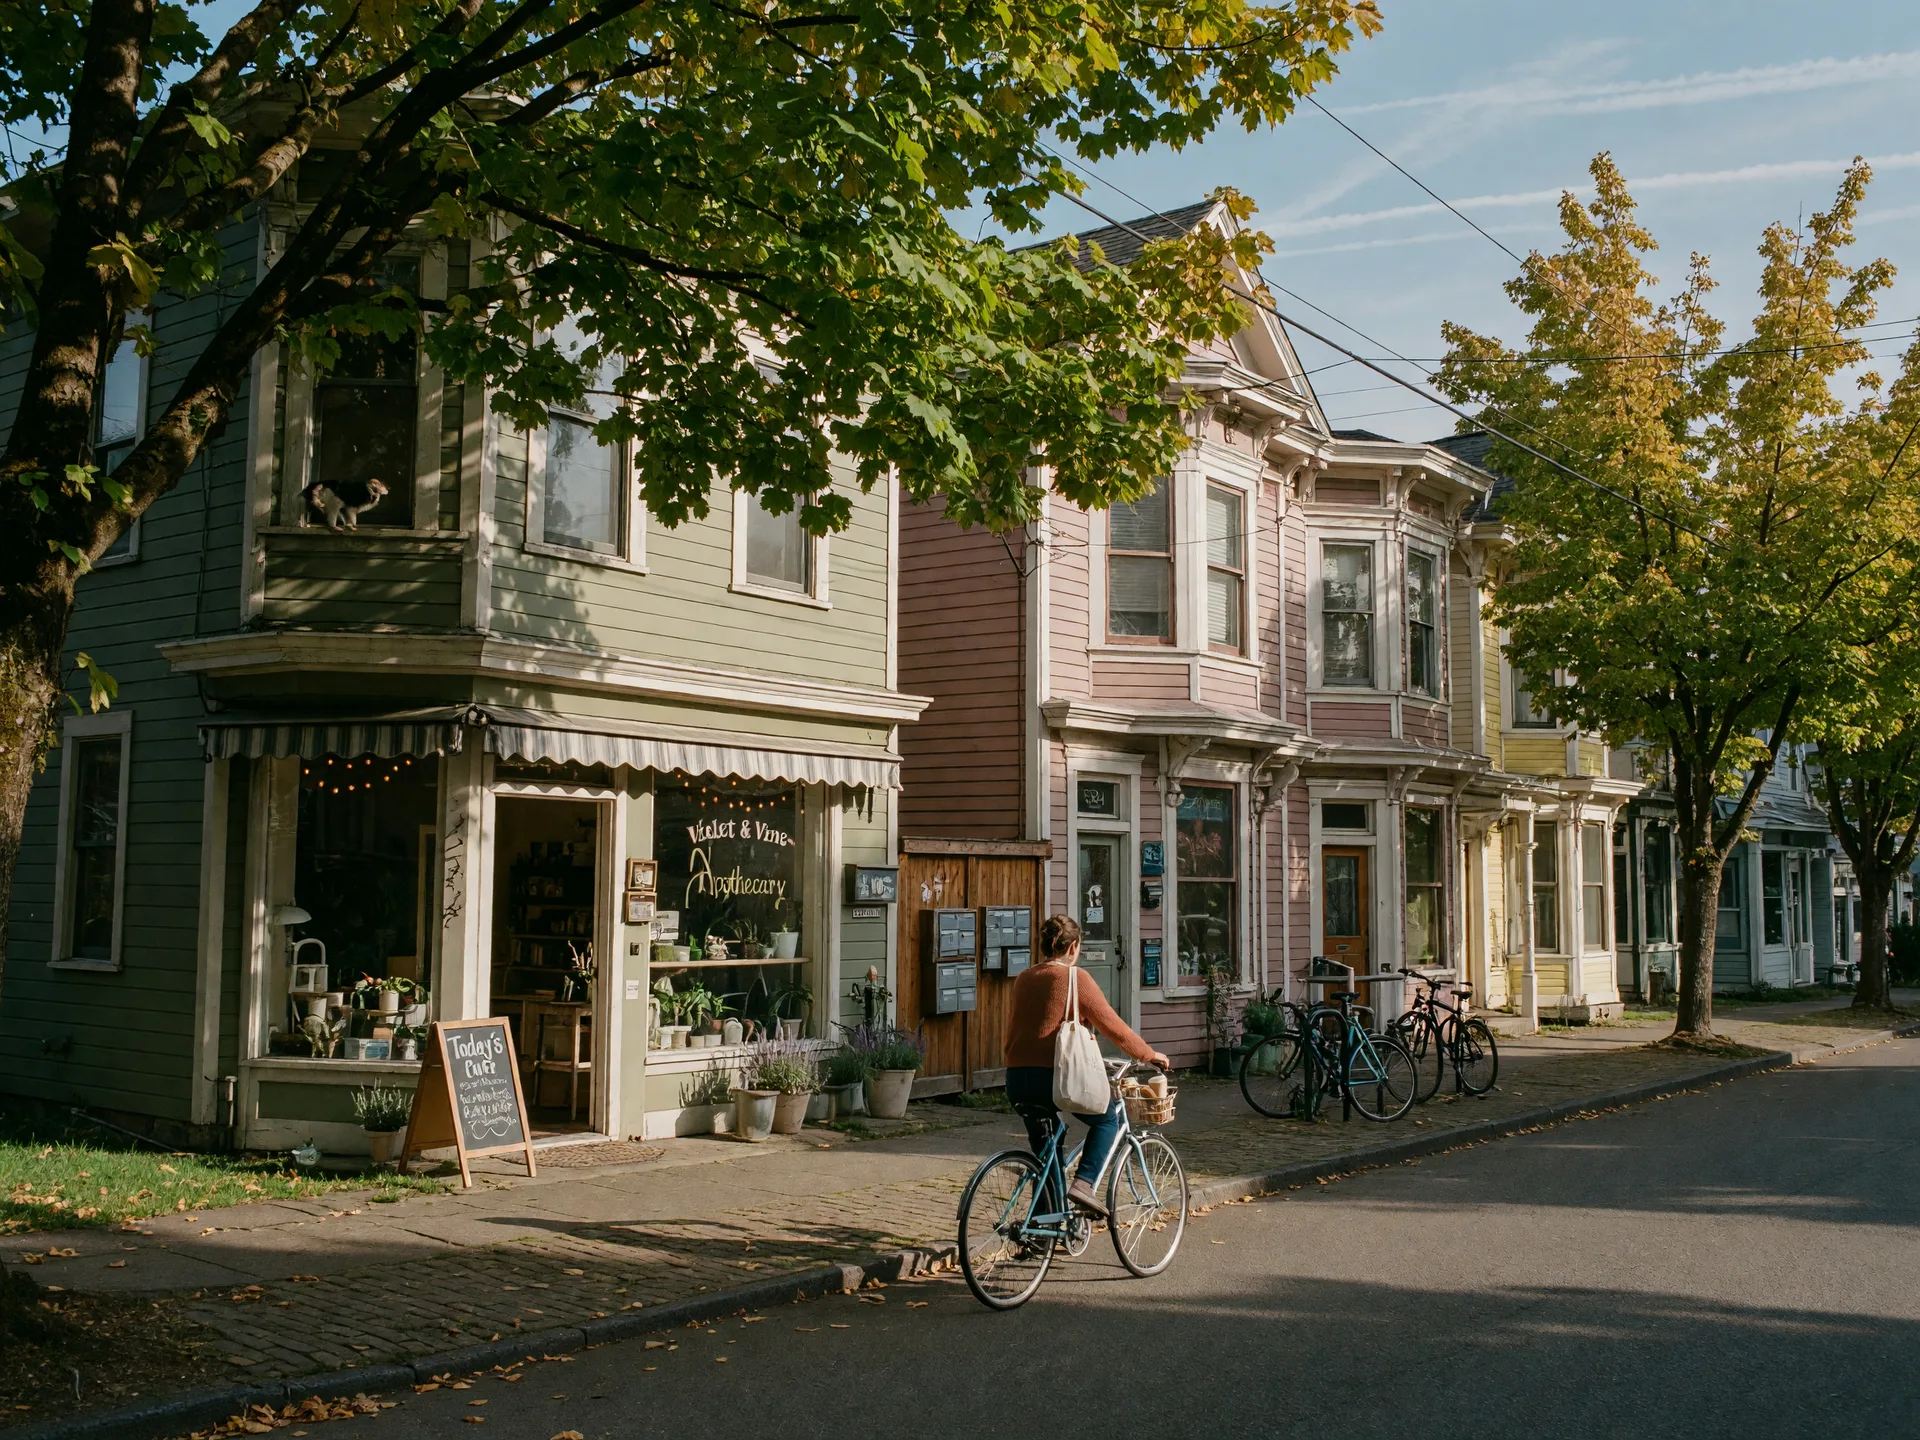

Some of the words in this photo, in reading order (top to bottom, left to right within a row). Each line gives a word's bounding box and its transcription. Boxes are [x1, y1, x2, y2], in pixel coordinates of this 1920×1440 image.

[686, 819, 736, 844] Violet
[740, 819, 752, 839] &
[755, 821, 788, 847] Vine
[685, 847, 787, 910] Apothecary
[446, 1031, 504, 1060] Today's
